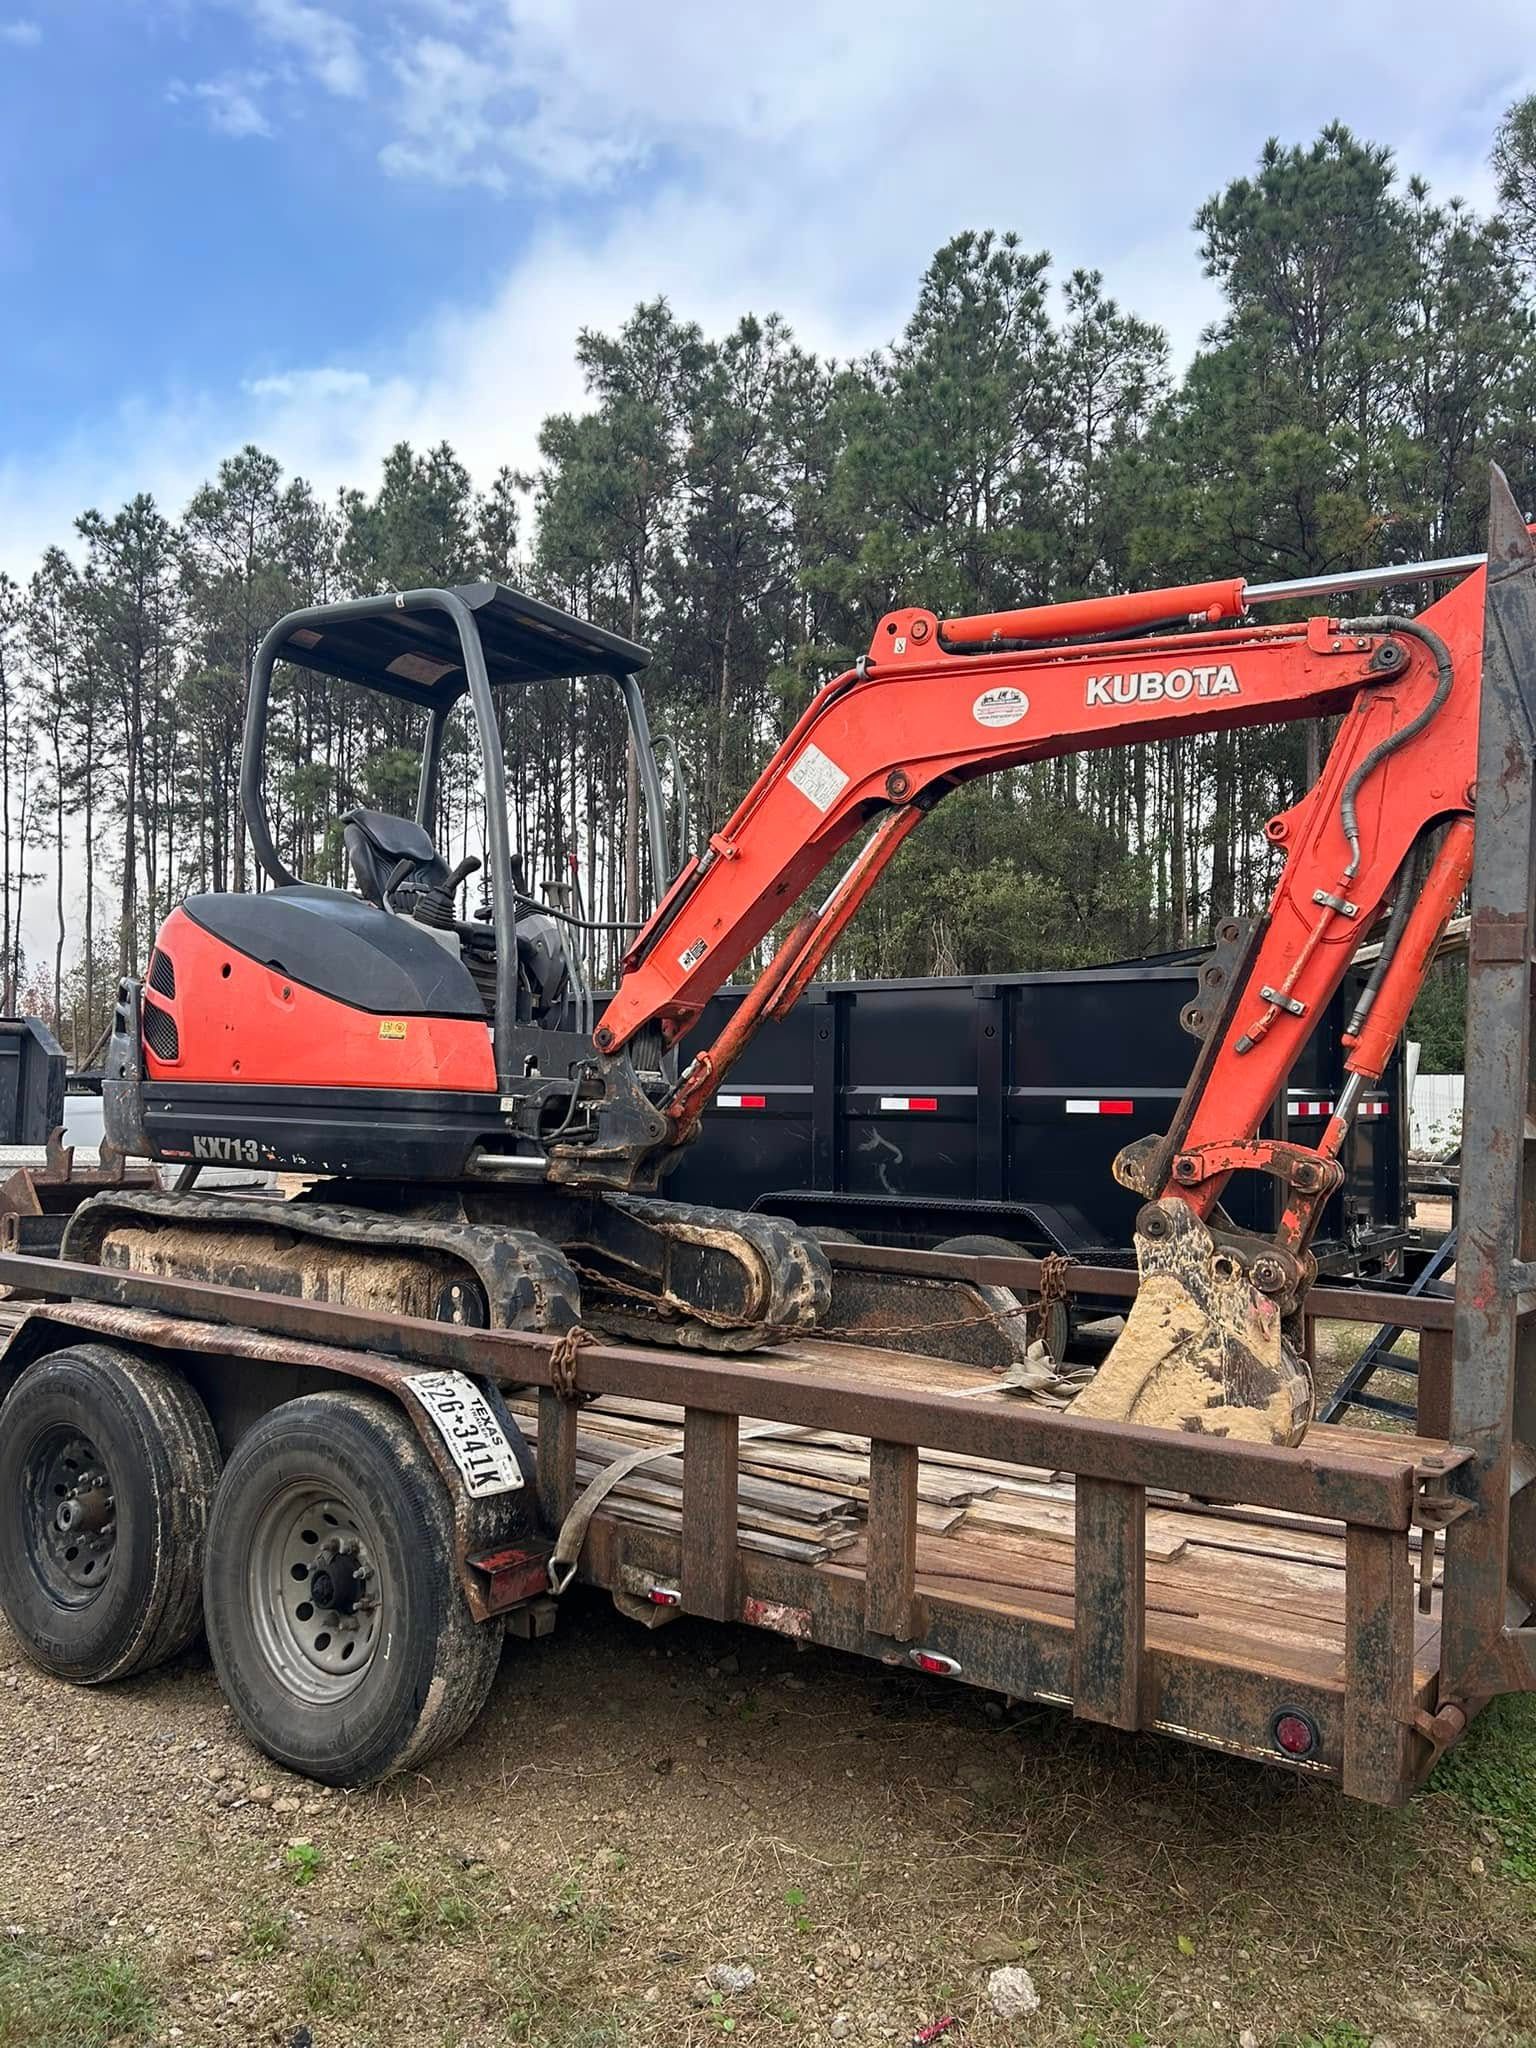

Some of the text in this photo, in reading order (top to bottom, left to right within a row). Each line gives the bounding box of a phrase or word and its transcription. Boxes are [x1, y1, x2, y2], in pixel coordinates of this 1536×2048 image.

[1086, 664, 1241, 705] KUBOTA
[193, 1136, 258, 1162] KX71-3
[471, 1397, 503, 1446] TEXAS
